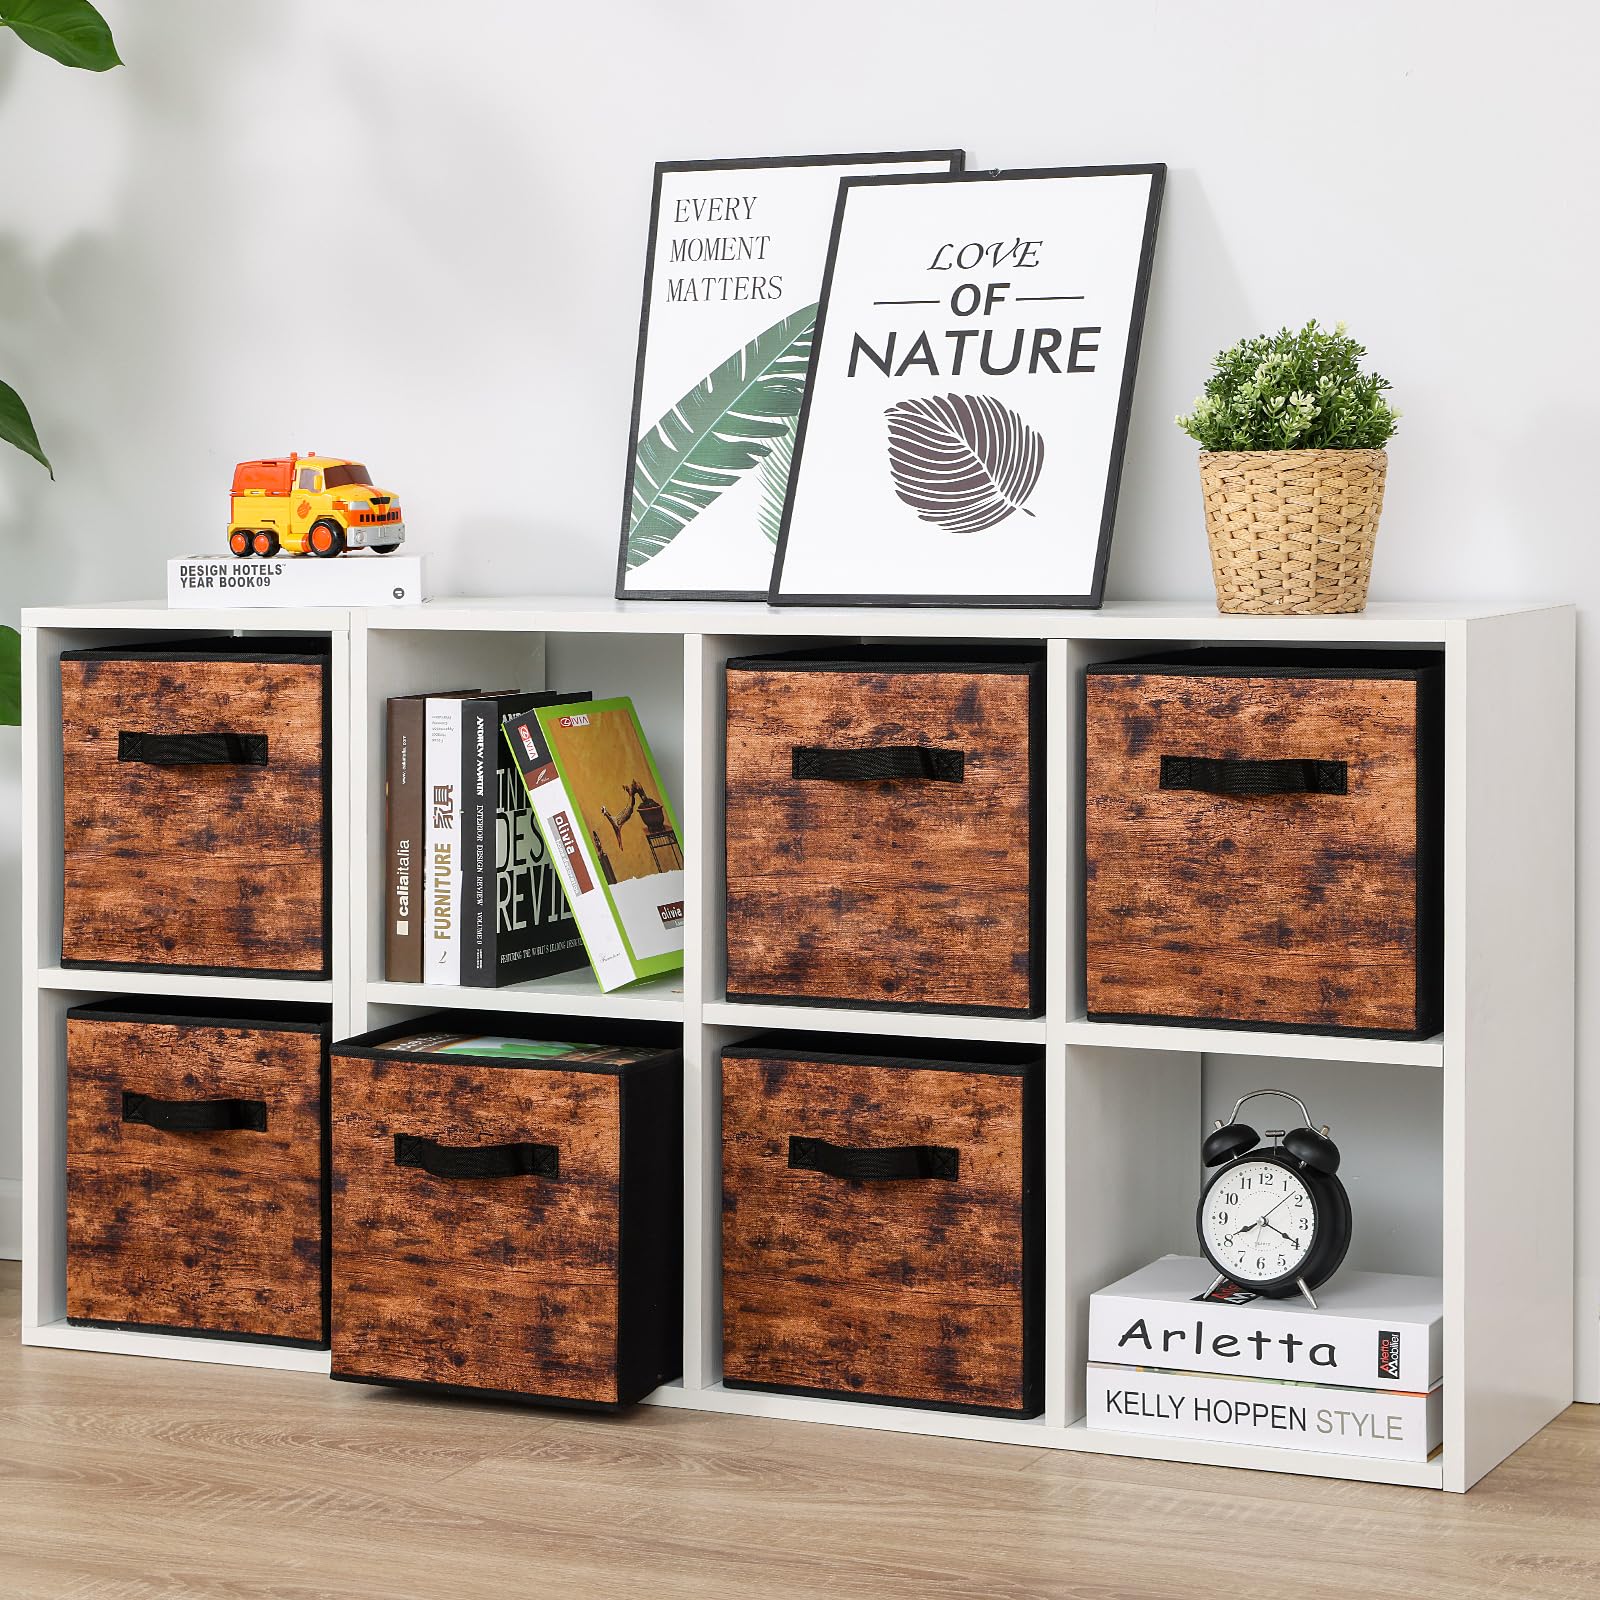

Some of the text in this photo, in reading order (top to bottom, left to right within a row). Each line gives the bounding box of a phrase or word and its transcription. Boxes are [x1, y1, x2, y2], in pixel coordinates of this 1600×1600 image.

[674, 196, 758, 223] EVERY
[669, 235, 771, 262] MOMENT
[926, 237, 1044, 271] LOVE
[666, 275, 783, 302] MATTERS
[950, 282, 1011, 317] OF
[847, 326, 1102, 378] NATURE
[180, 565, 228, 577] DESIGN
[180, 576, 214, 588] YEAR
[476, 715, 484, 797] ANDREW MARTIN
[555, 816, 575, 855] olivia
[476, 804, 484, 906] INTERIOR DESIGN REVIEW
[396, 839, 410, 917] caliaitalia
[434, 843, 451, 940] FURNITURE
[661, 906, 683, 920] olivia
[1239, 1177, 1252, 1190] 11
[1258, 1172, 1274, 1186] 12
[1282, 1180, 1288, 1192] 1
[1225, 1192, 1239, 1206] 10
[1294, 1194, 1304, 1208] 2
[1218, 1211, 1229, 1226] 9
[1299, 1217, 1309, 1231] 3
[1223, 1233, 1234, 1248] 8
[1290, 1237, 1301, 1251] 4
[1237, 1250, 1246, 1263] 7
[1256, 1257, 1266, 1270] 6
[1277, 1253, 1287, 1267] 5
[1117, 1318, 1338, 1368] Arletta
[1379, 1339, 1390, 1373] Arletta
[1388, 1333, 1400, 1378] Mobilier
[1106, 1389, 1404, 1441] KELLY HOPPEN STYLE
